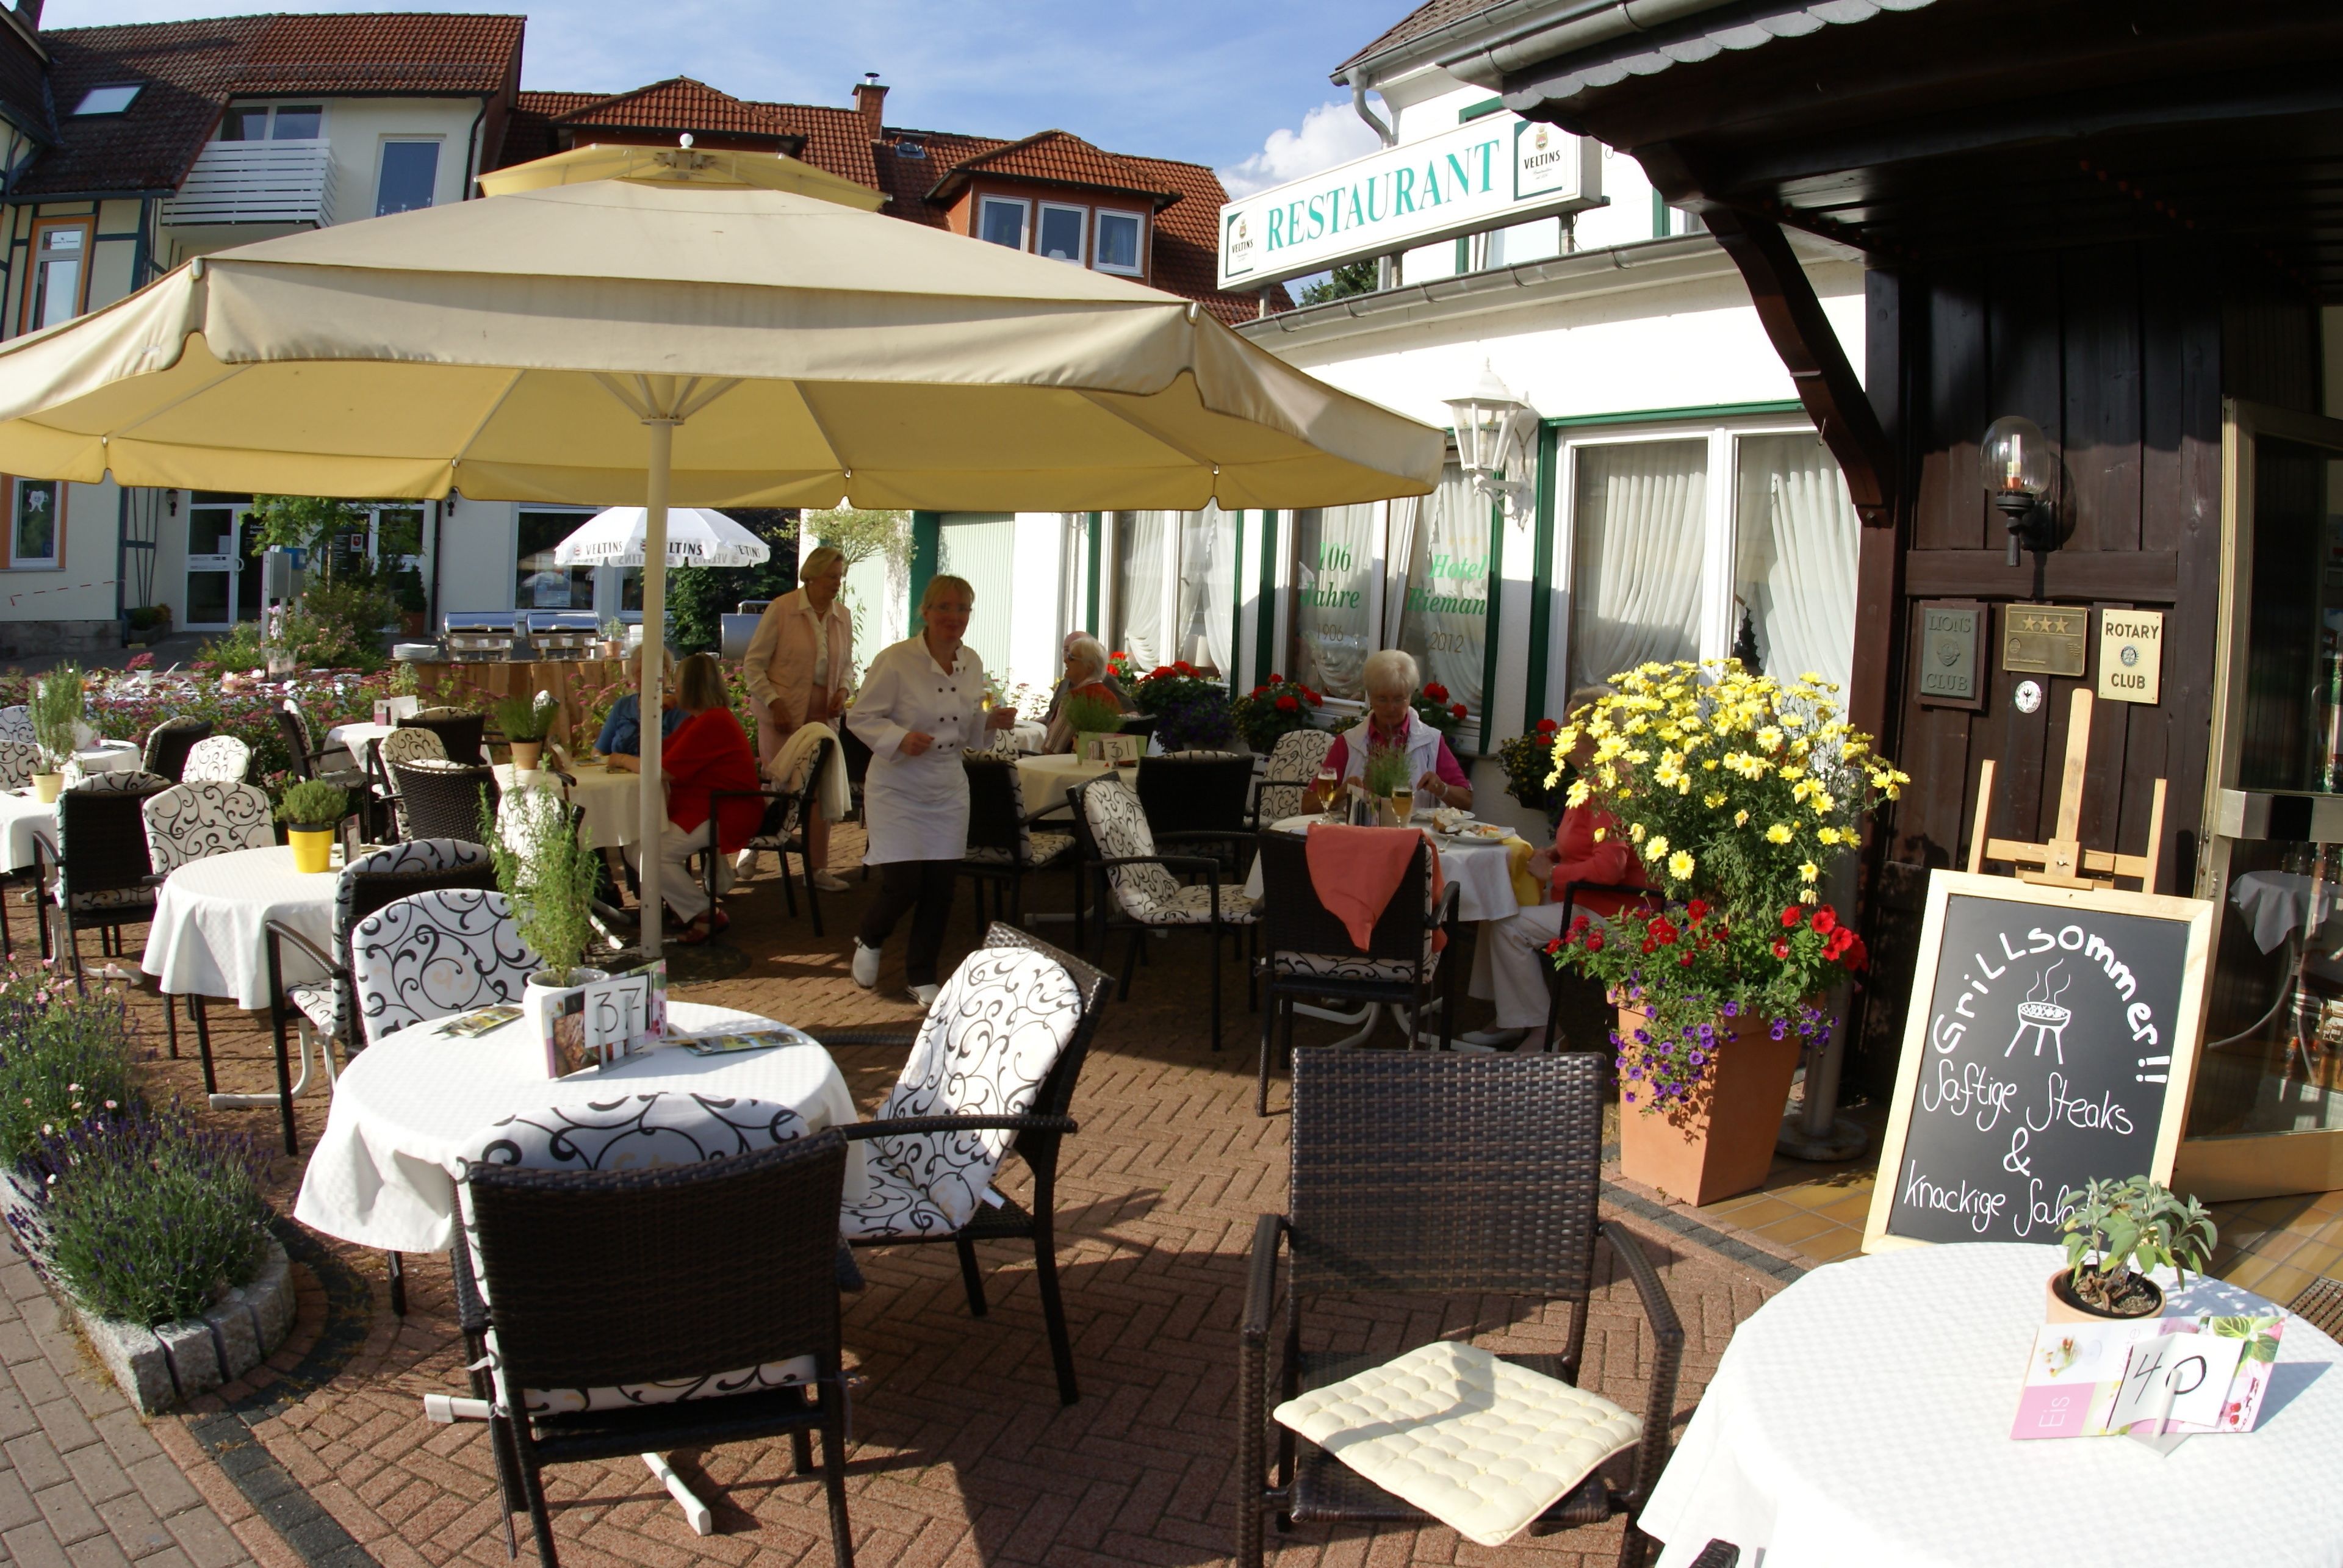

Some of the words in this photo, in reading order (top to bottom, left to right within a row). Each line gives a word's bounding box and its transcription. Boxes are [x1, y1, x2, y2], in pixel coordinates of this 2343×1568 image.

[1524, 149, 1561, 170] VELTINS
[1266, 138, 1500, 253] RESTAURANT
[1231, 239, 1253, 254] VELTINS
[586, 541, 622, 555] VELTINS
[666, 542, 703, 556] LTINS
[1317, 541, 1352, 572] 106
[1428, 554, 1489, 580] Hotel
[1300, 581, 1361, 610] Jahre
[1316, 624, 1344, 642] 1906
[1928, 615, 1971, 633] LIONS
[2105, 622, 2159, 640] ROTARY
[1430, 632, 1464, 653] 2012
[1926, 673, 1968, 691] CLUB
[2111, 673, 2145, 689] CLUB
[1107, 741, 1130, 758] 31
[594, 987, 642, 1033] 37
[1923, 1059, 2017, 1132] Saftige
[2026, 1072, 2134, 1135] Steaks
[2003, 1127, 2031, 1176] &
[2133, 1351, 2207, 1405] 40
[2039, 1397, 2070, 1427] Eis
